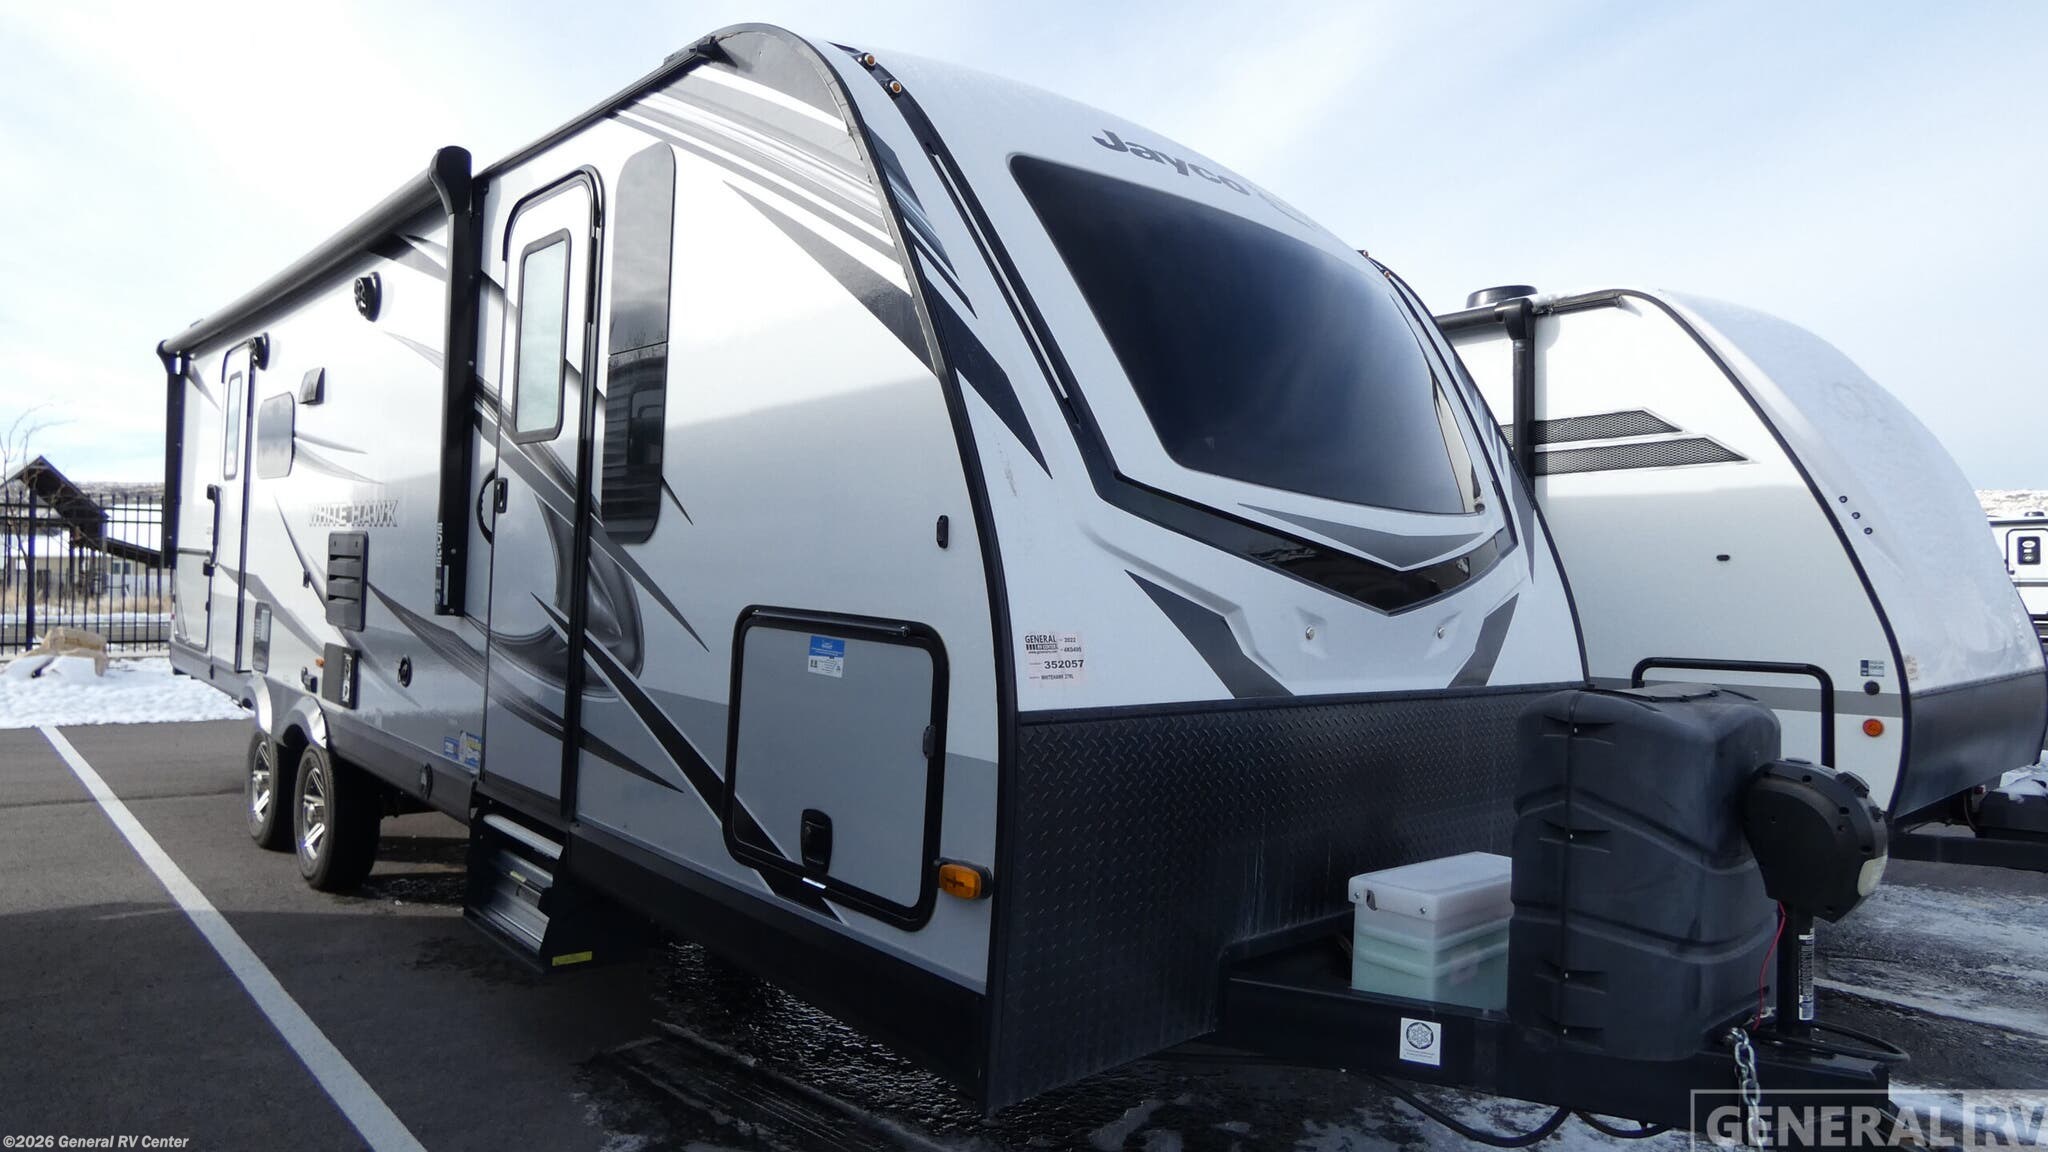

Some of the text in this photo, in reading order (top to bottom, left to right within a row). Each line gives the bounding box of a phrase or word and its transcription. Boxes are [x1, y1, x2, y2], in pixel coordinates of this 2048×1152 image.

[1092, 129, 1250, 196] Jayco
[309, 500, 398, 527] WHITE HAWK
[1025, 634, 1056, 643] GENERAL
[1044, 660, 1084, 669] 352057
